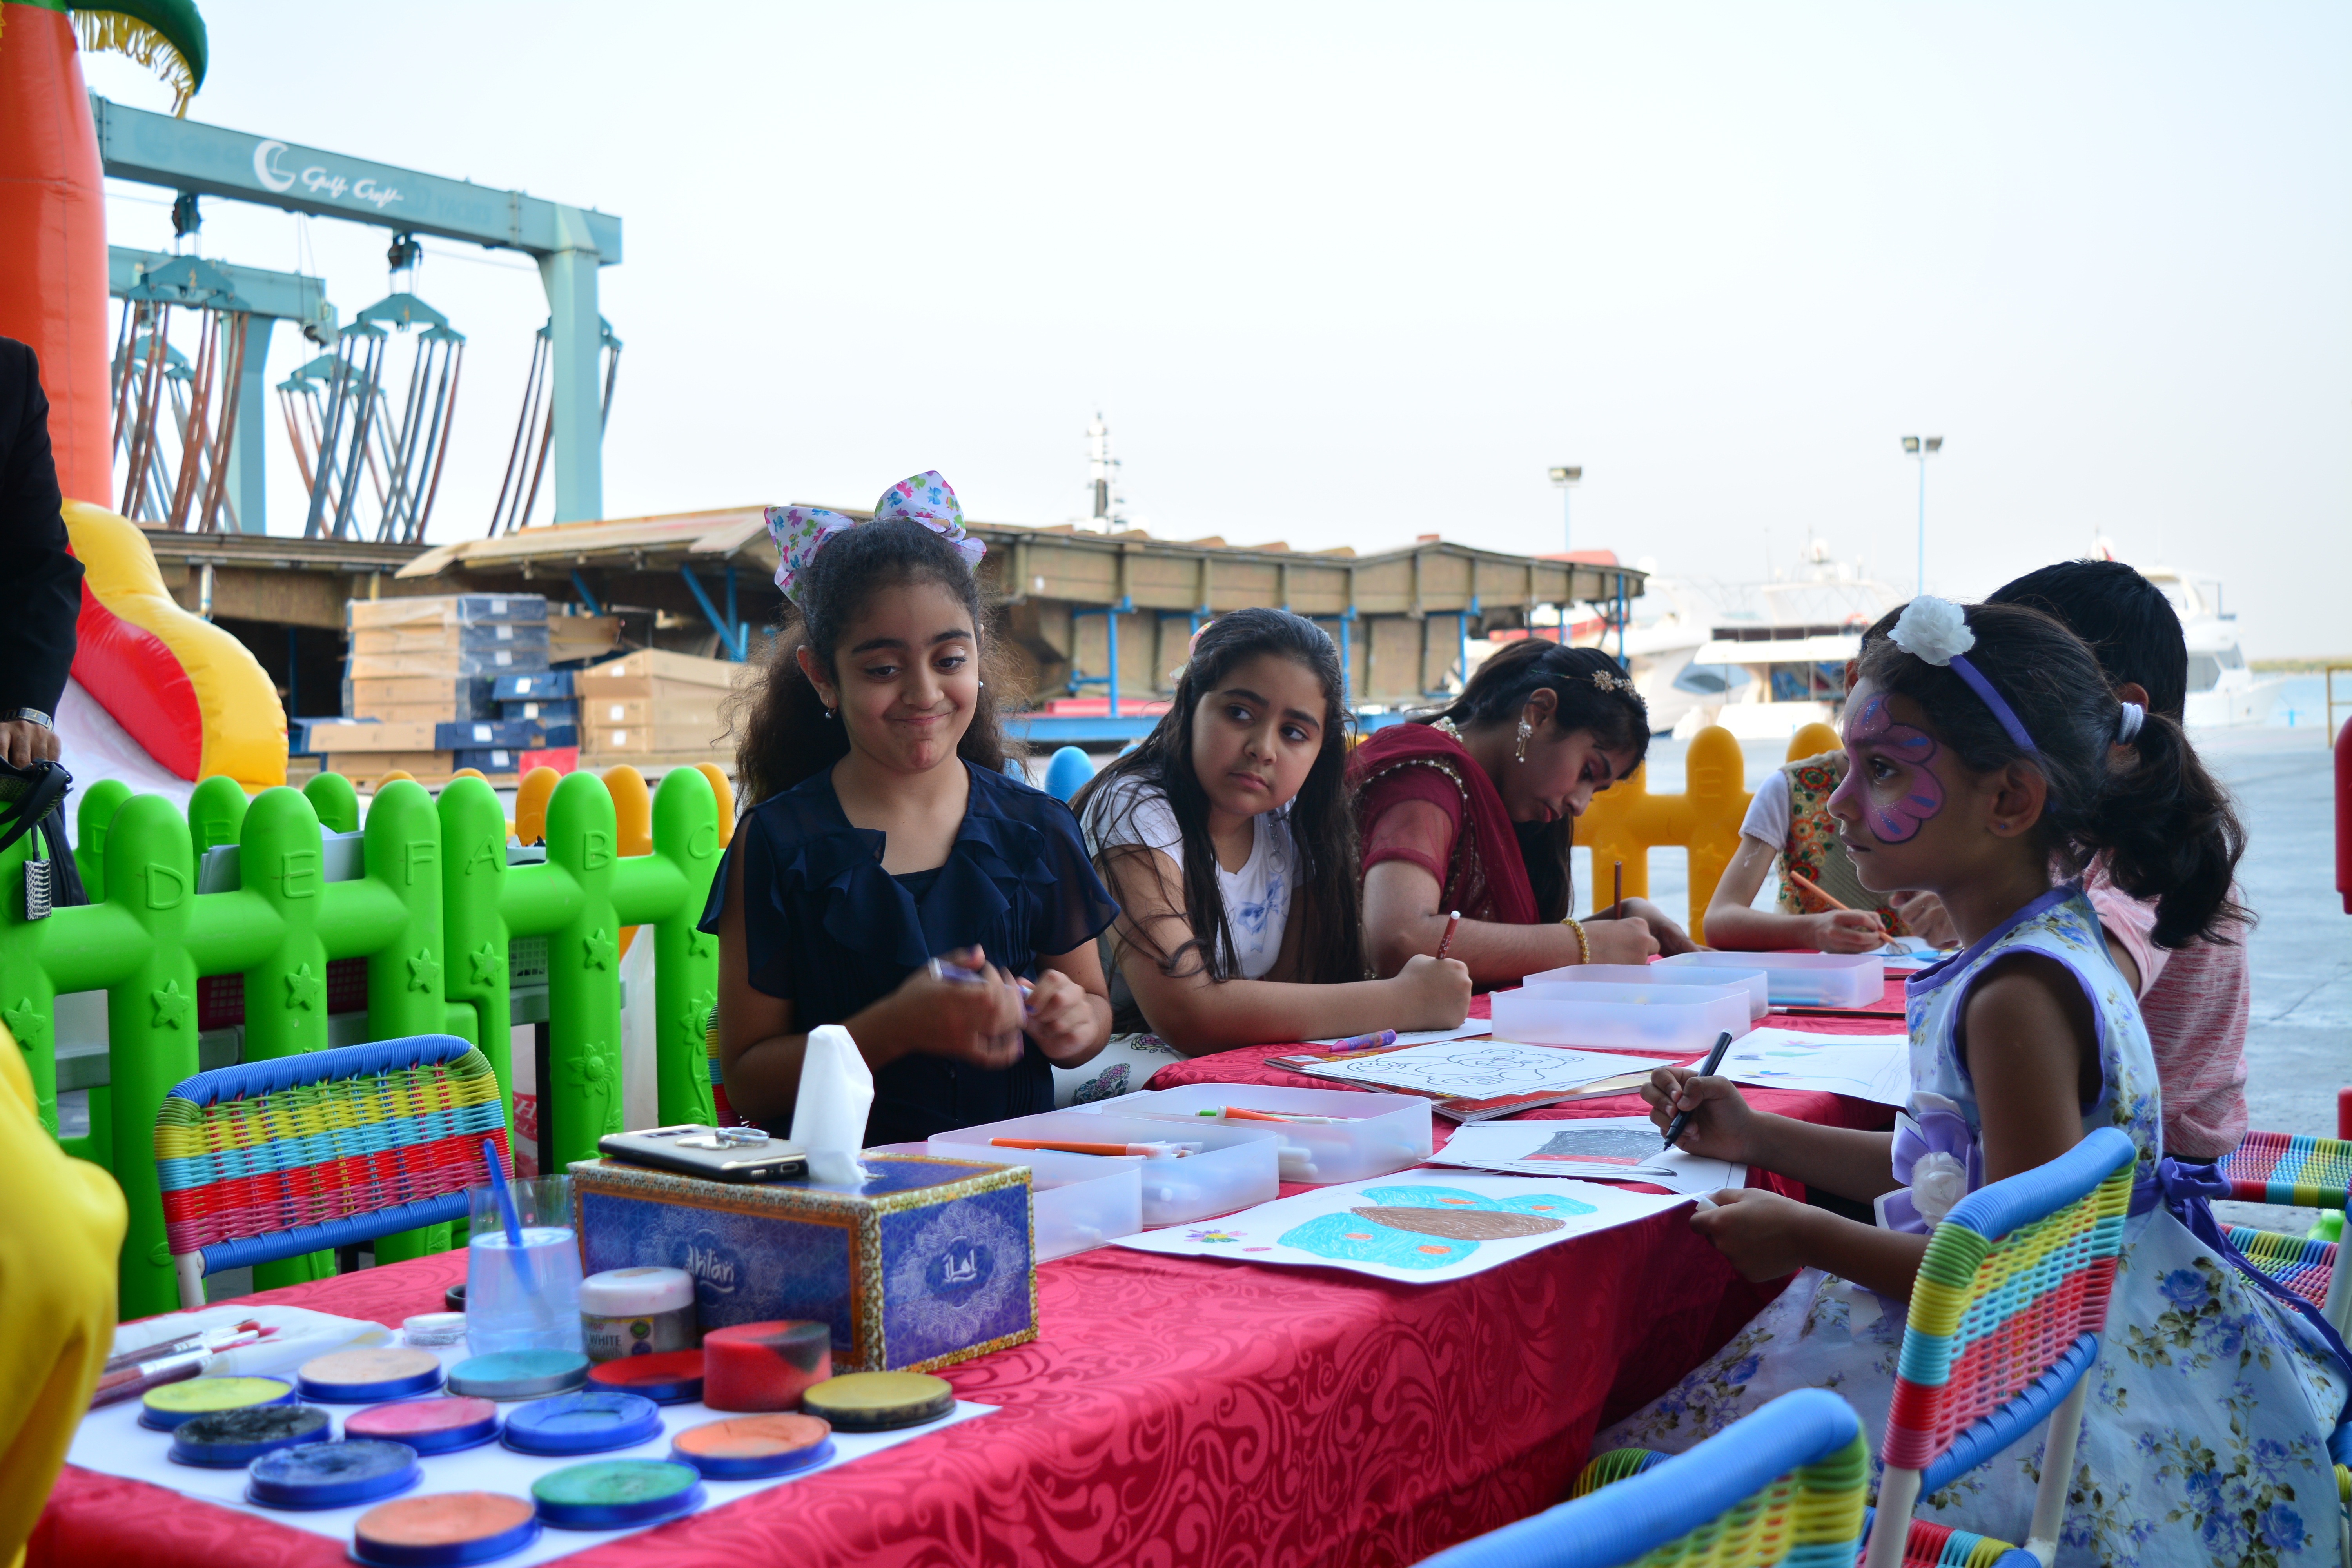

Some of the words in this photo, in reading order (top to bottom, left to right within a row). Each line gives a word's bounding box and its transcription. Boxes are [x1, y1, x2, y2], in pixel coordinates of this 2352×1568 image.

[146, 862, 188, 909] D
[282, 851, 316, 898] E
[406, 840, 436, 886] F
[465, 835, 503, 875] A
[584, 831, 612, 870] B
[688, 820, 716, 859] C
[589, 1333, 621, 1346] WHITE
